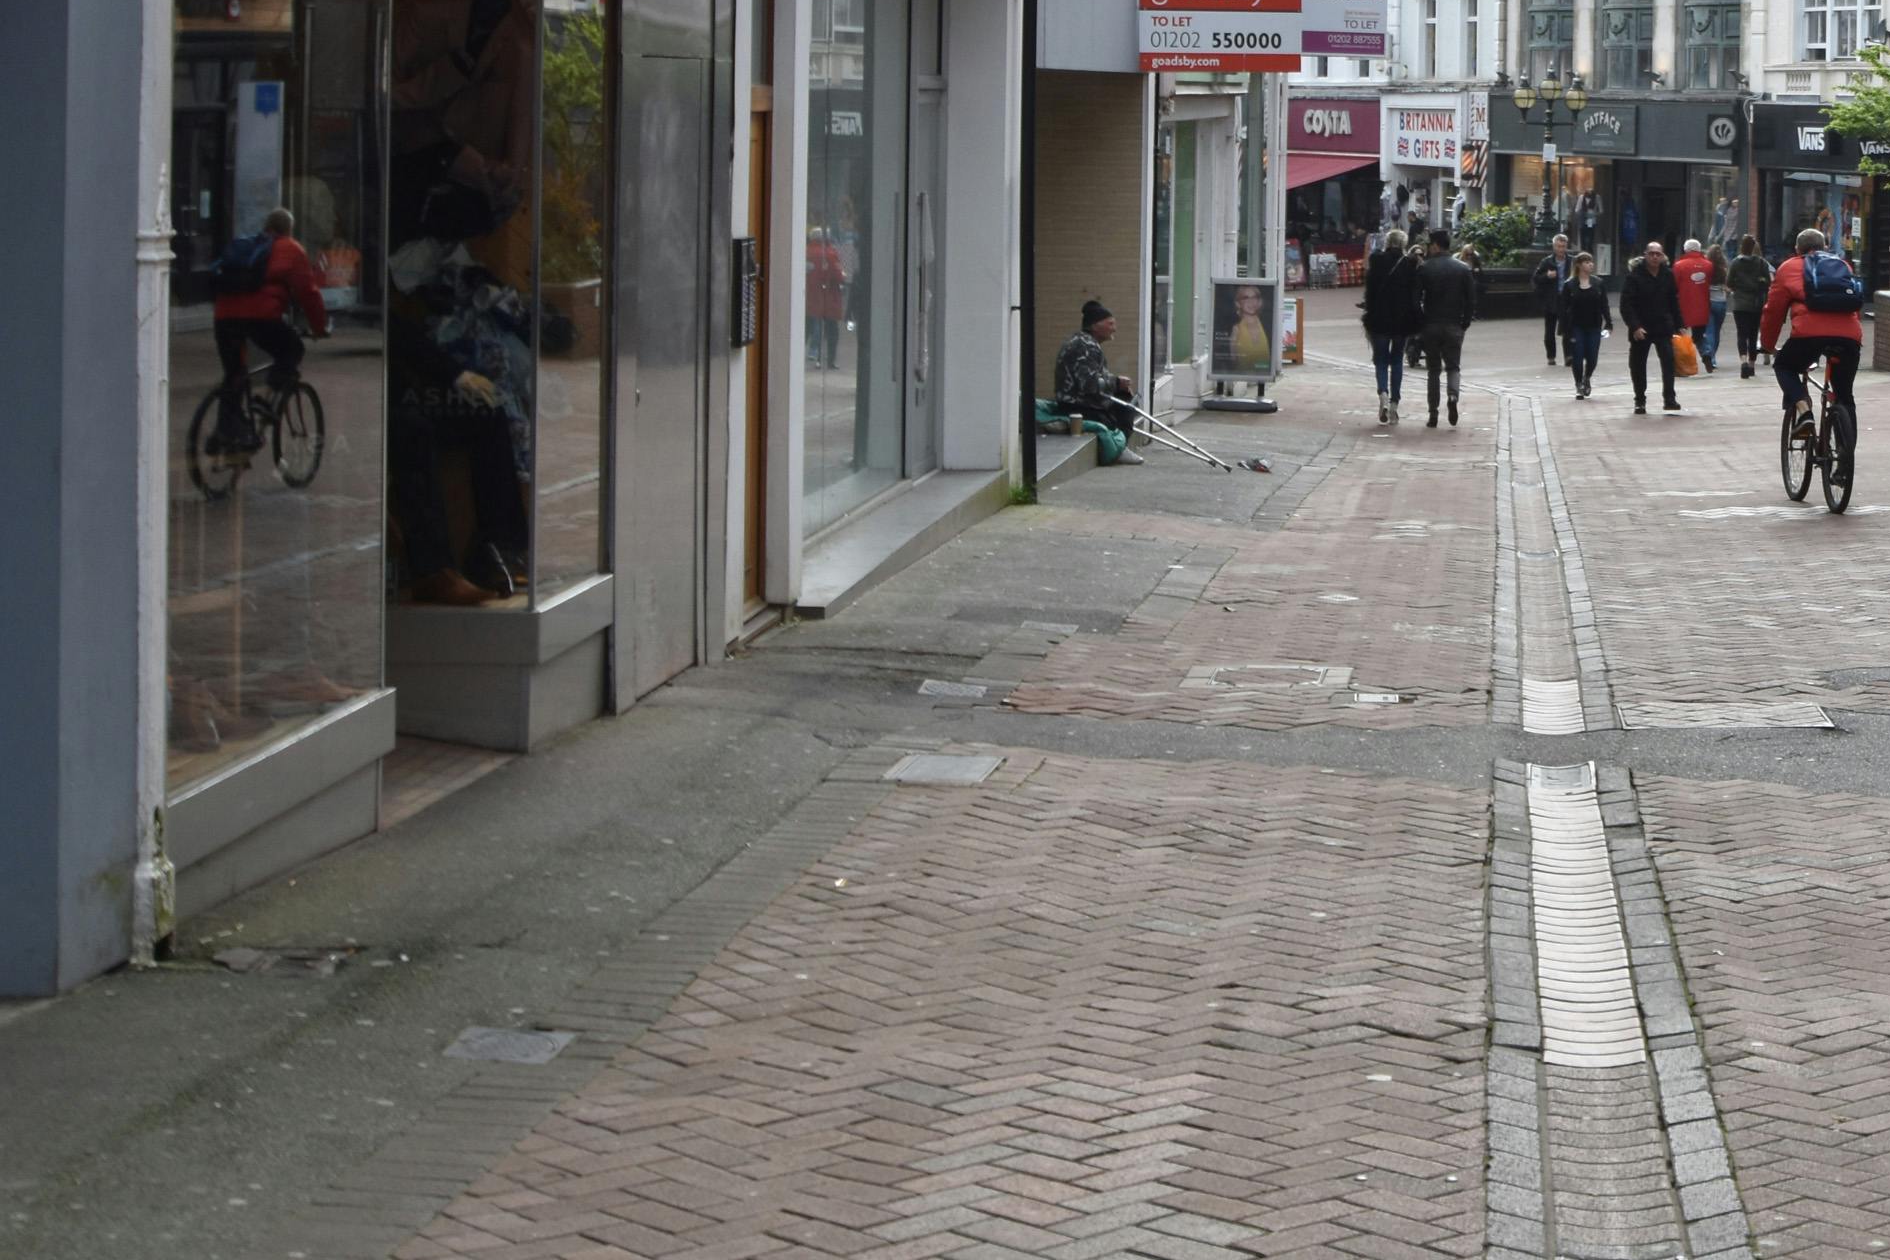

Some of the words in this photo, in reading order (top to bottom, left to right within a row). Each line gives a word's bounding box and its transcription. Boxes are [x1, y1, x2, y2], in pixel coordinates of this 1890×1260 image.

[1152, 16, 1169, 27] TO
[1172, 17, 1192, 28] LET
[1344, 20, 1358, 29] TO
[1361, 20, 1378, 30] LET
[1150, 31, 1201, 49] 01202
[1211, 32, 1282, 49] 550000
[1327, 34, 1352, 44] 01202
[1151, 55, 1221, 68] goadsby.com
[1303, 108, 1352, 137] COSTA
[1399, 111, 1454, 133] BRITANNIA
[1583, 111, 1621, 135] FATFACE
[1797, 126, 1826, 151] VANS
[1413, 138, 1441, 160] GIFTS
